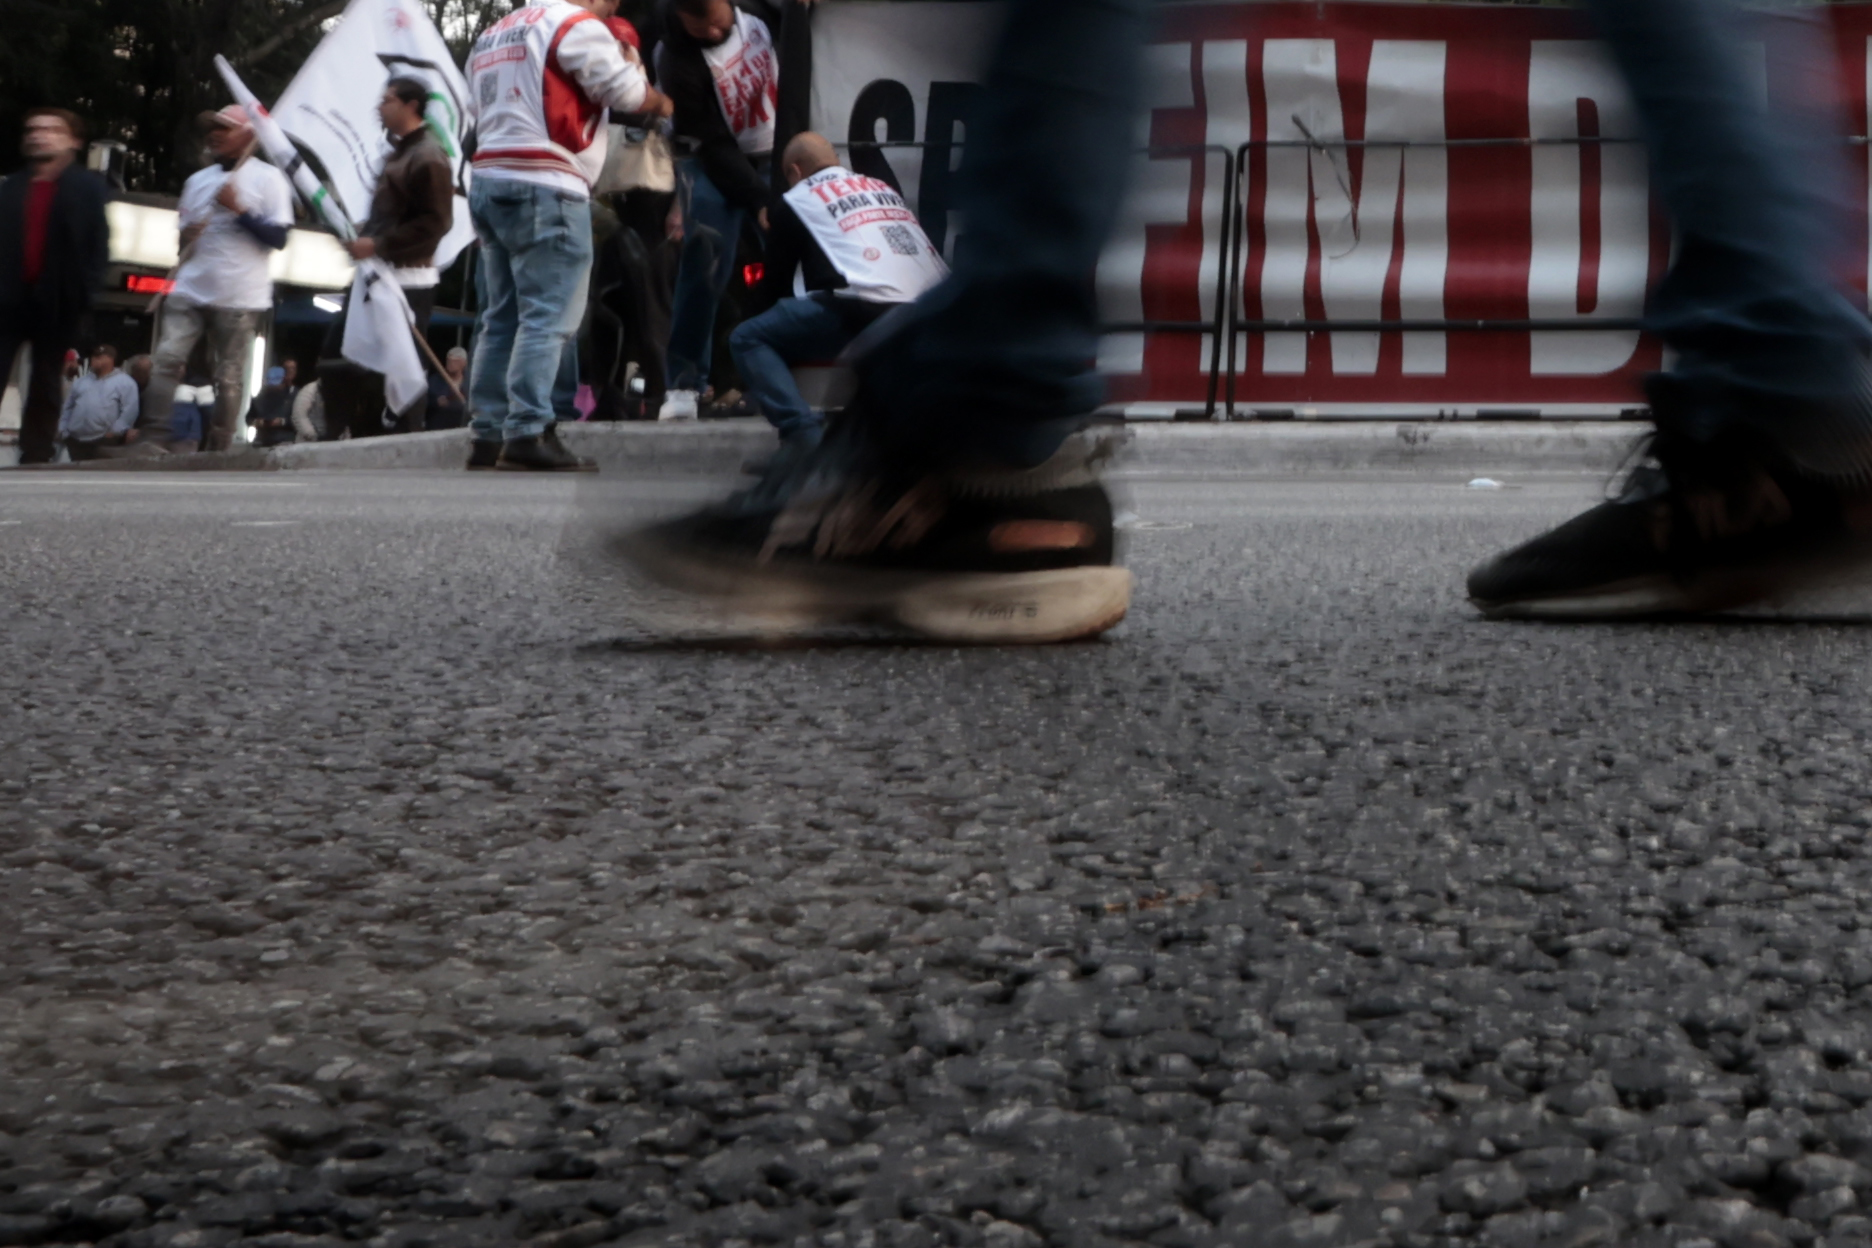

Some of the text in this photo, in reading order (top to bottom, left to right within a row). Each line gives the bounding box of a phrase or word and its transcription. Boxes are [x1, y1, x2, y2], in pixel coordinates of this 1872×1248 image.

[809, 175, 892, 204] TEMP
[827, 193, 873, 219] PARA
[871, 191, 907, 209] VIVE
